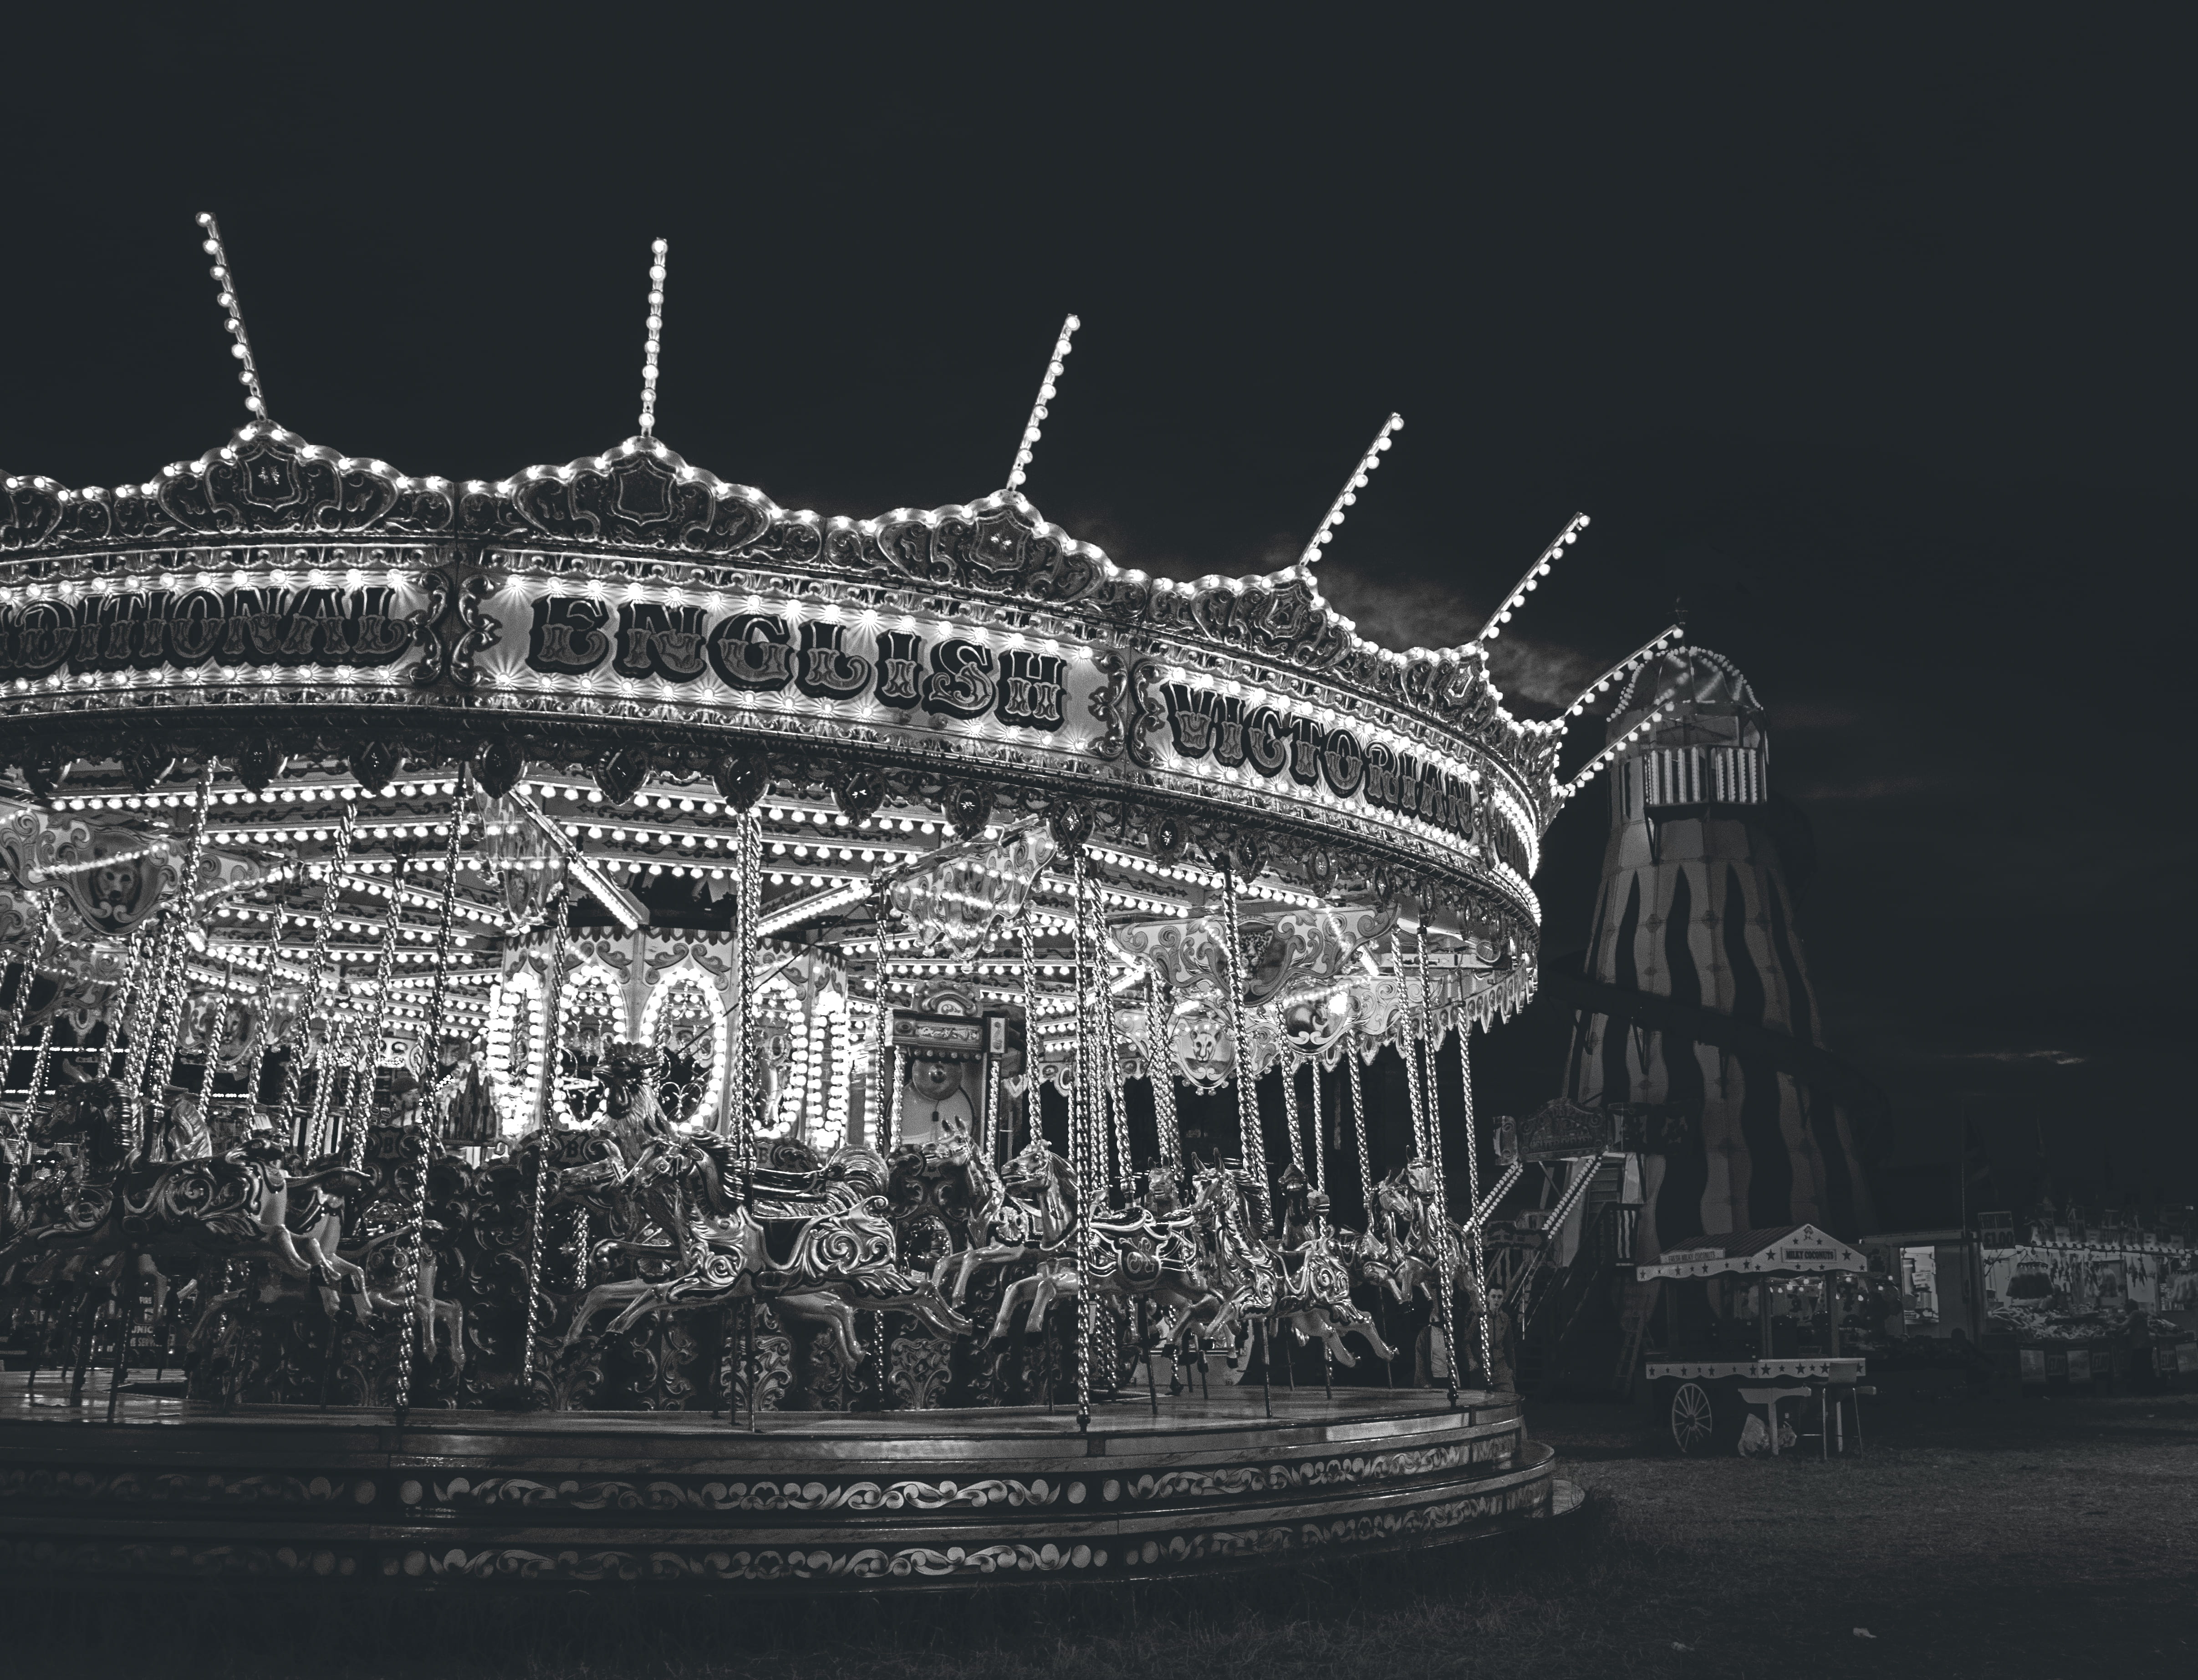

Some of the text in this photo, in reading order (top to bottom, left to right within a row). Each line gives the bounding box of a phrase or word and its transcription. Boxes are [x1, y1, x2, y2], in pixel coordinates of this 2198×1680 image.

[525, 595, 1068, 732] ENGLISH
[1160, 680, 1474, 843] VICTORIAN
[566, 1140, 578, 1158] B
[1695, 1251, 1715, 1259] COCONUTS
[1786, 1251, 1834, 1259] MILKY COCONUTS
